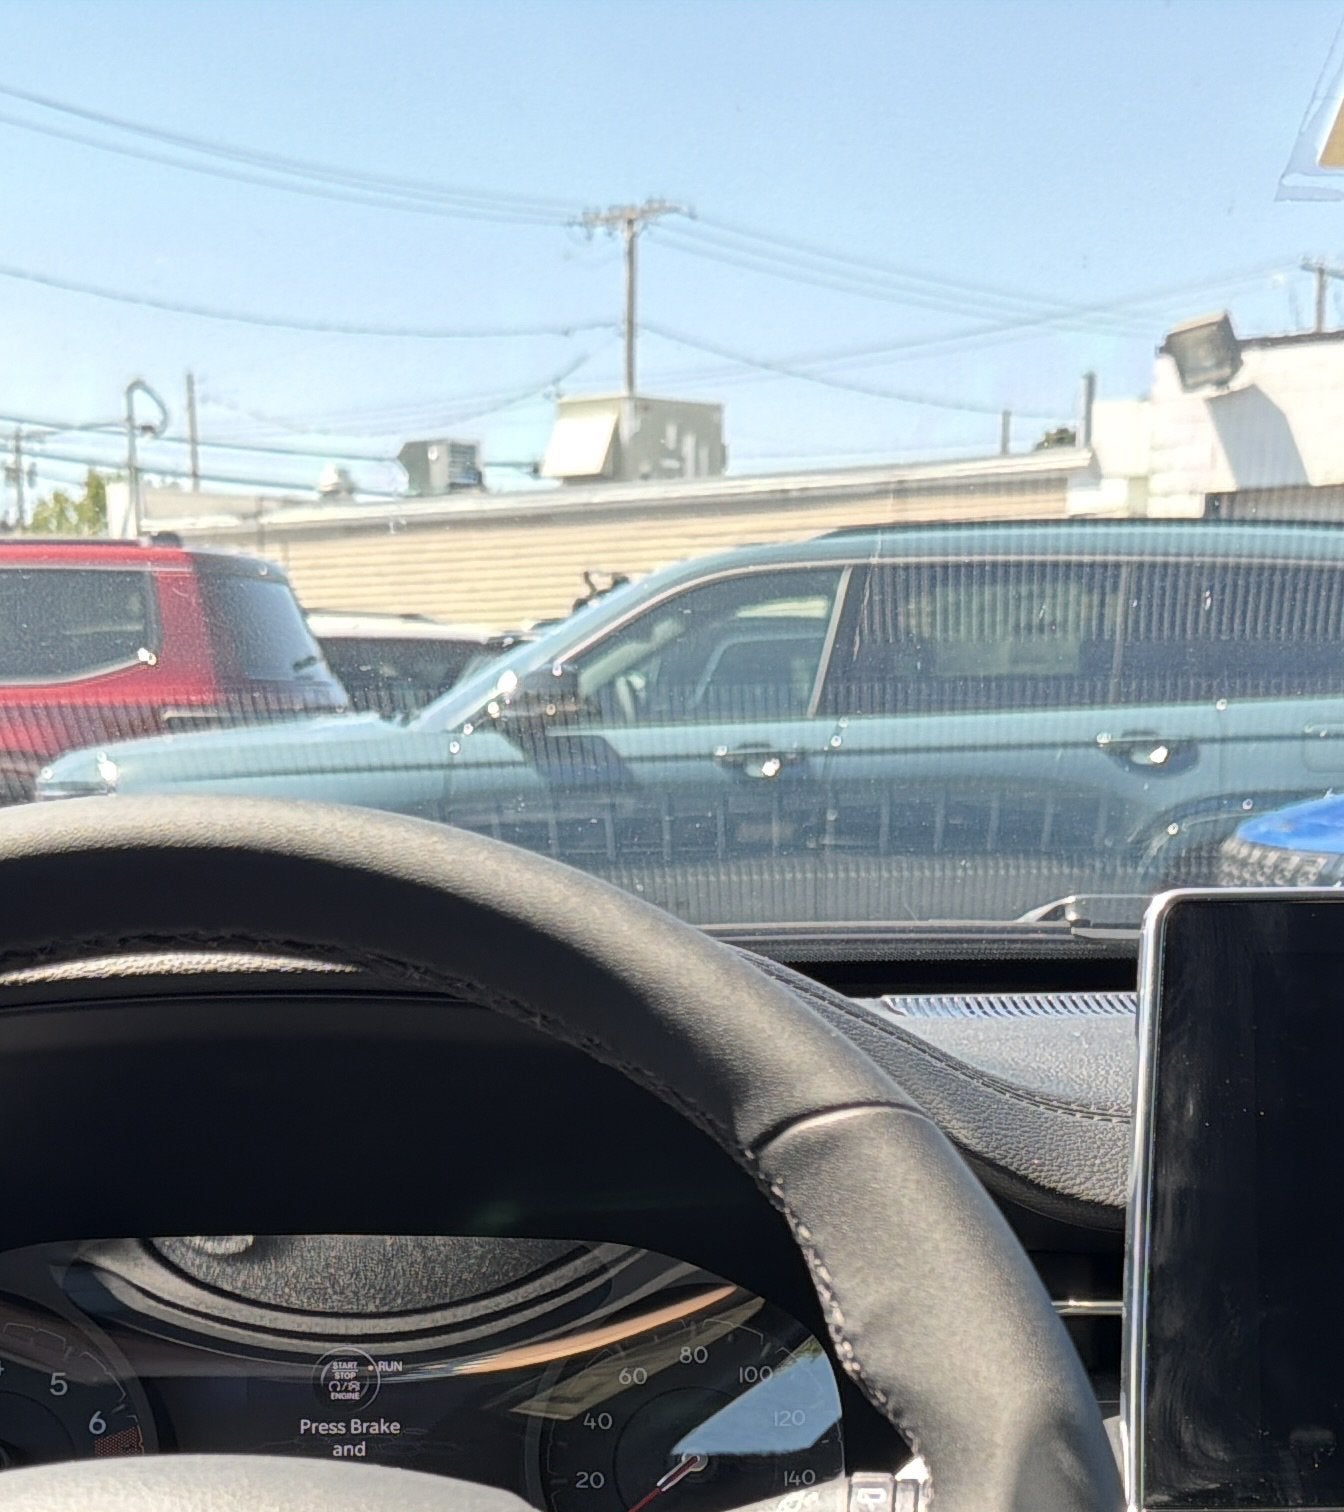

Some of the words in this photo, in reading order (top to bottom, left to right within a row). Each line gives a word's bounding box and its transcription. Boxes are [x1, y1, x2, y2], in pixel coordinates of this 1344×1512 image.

[678, 1345, 709, 1364] 80
[331, 1361, 358, 1370] START
[377, 1361, 403, 1372] RUN
[738, 1365, 773, 1384] 100
[49, 1372, 69, 1397] 5
[333, 1371, 357, 1380] STOP
[618, 1366, 648, 1385] 60
[330, 1391, 361, 1401] ENGINE
[88, 1410, 107, 1435] 6
[299, 1418, 347, 1435] Press
[350, 1418, 401, 1435] Brake
[582, 1411, 613, 1430] 40
[773, 1409, 806, 1427] 120
[332, 1440, 366, 1457] and
[575, 1470, 605, 1489] 20
[783, 1469, 816, 1487] 140
